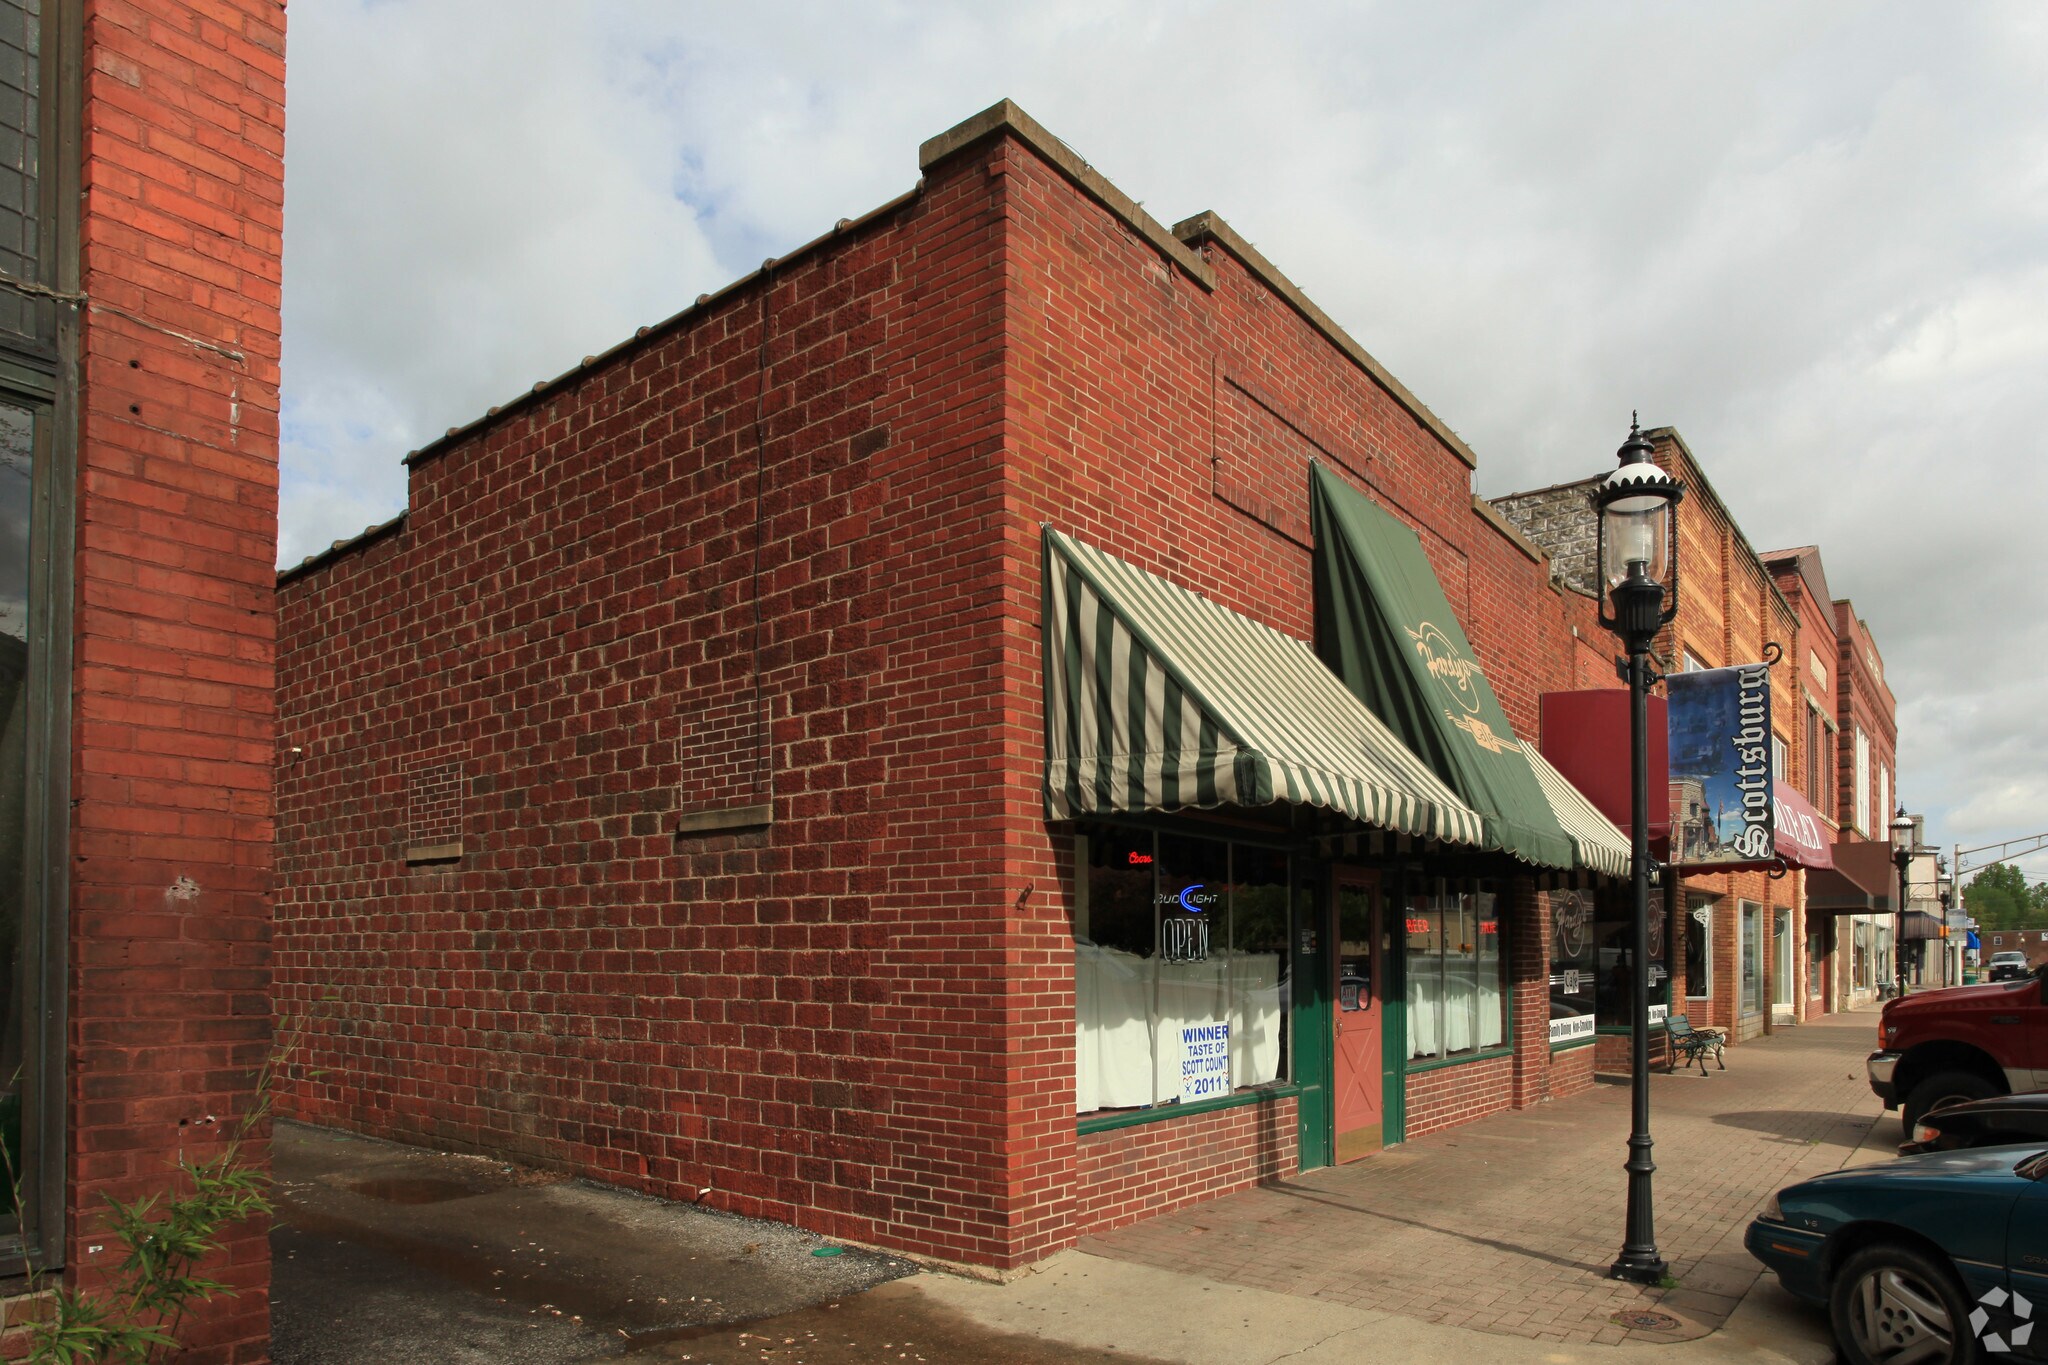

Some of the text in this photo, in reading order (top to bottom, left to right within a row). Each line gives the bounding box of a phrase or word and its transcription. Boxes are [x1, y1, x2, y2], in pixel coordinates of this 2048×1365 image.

[1732, 667, 1770, 858] Scottsburg
[1128, 851, 1152, 864] Coors
[1187, 894, 1218, 904] LIGHT
[1406, 919, 1429, 933] BEER
[1163, 918, 1209, 962] OPEN
[1182, 1025, 1229, 1043] WINNER
[1188, 1042, 1225, 1057] TASTE OF
[1182, 1058, 1203, 1076] SCOTT
[1195, 1076, 1221, 1095] 2011
